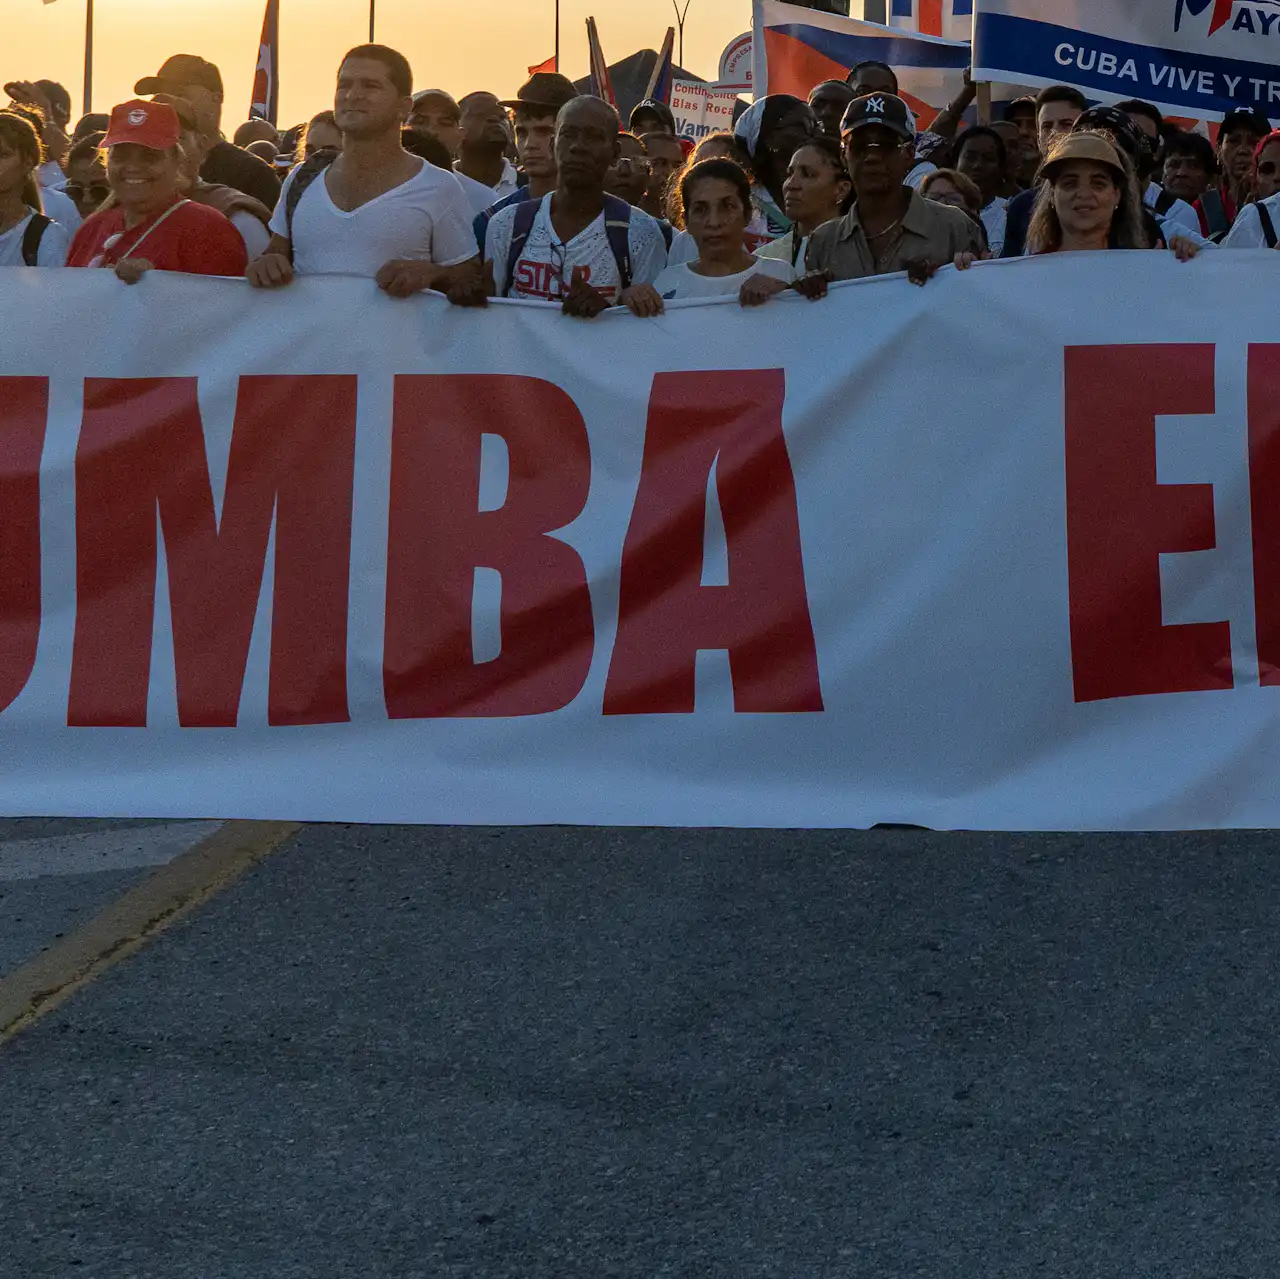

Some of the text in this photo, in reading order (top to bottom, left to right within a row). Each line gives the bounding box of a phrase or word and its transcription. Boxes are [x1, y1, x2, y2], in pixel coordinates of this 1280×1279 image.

[1054, 42, 1138, 82] CUBA
[1149, 63, 1215, 95] VIVE
[1222, 74, 1242, 97] Y
[672, 98, 734, 116] Blas Roca
[0, 368, 824, 727] MBA
